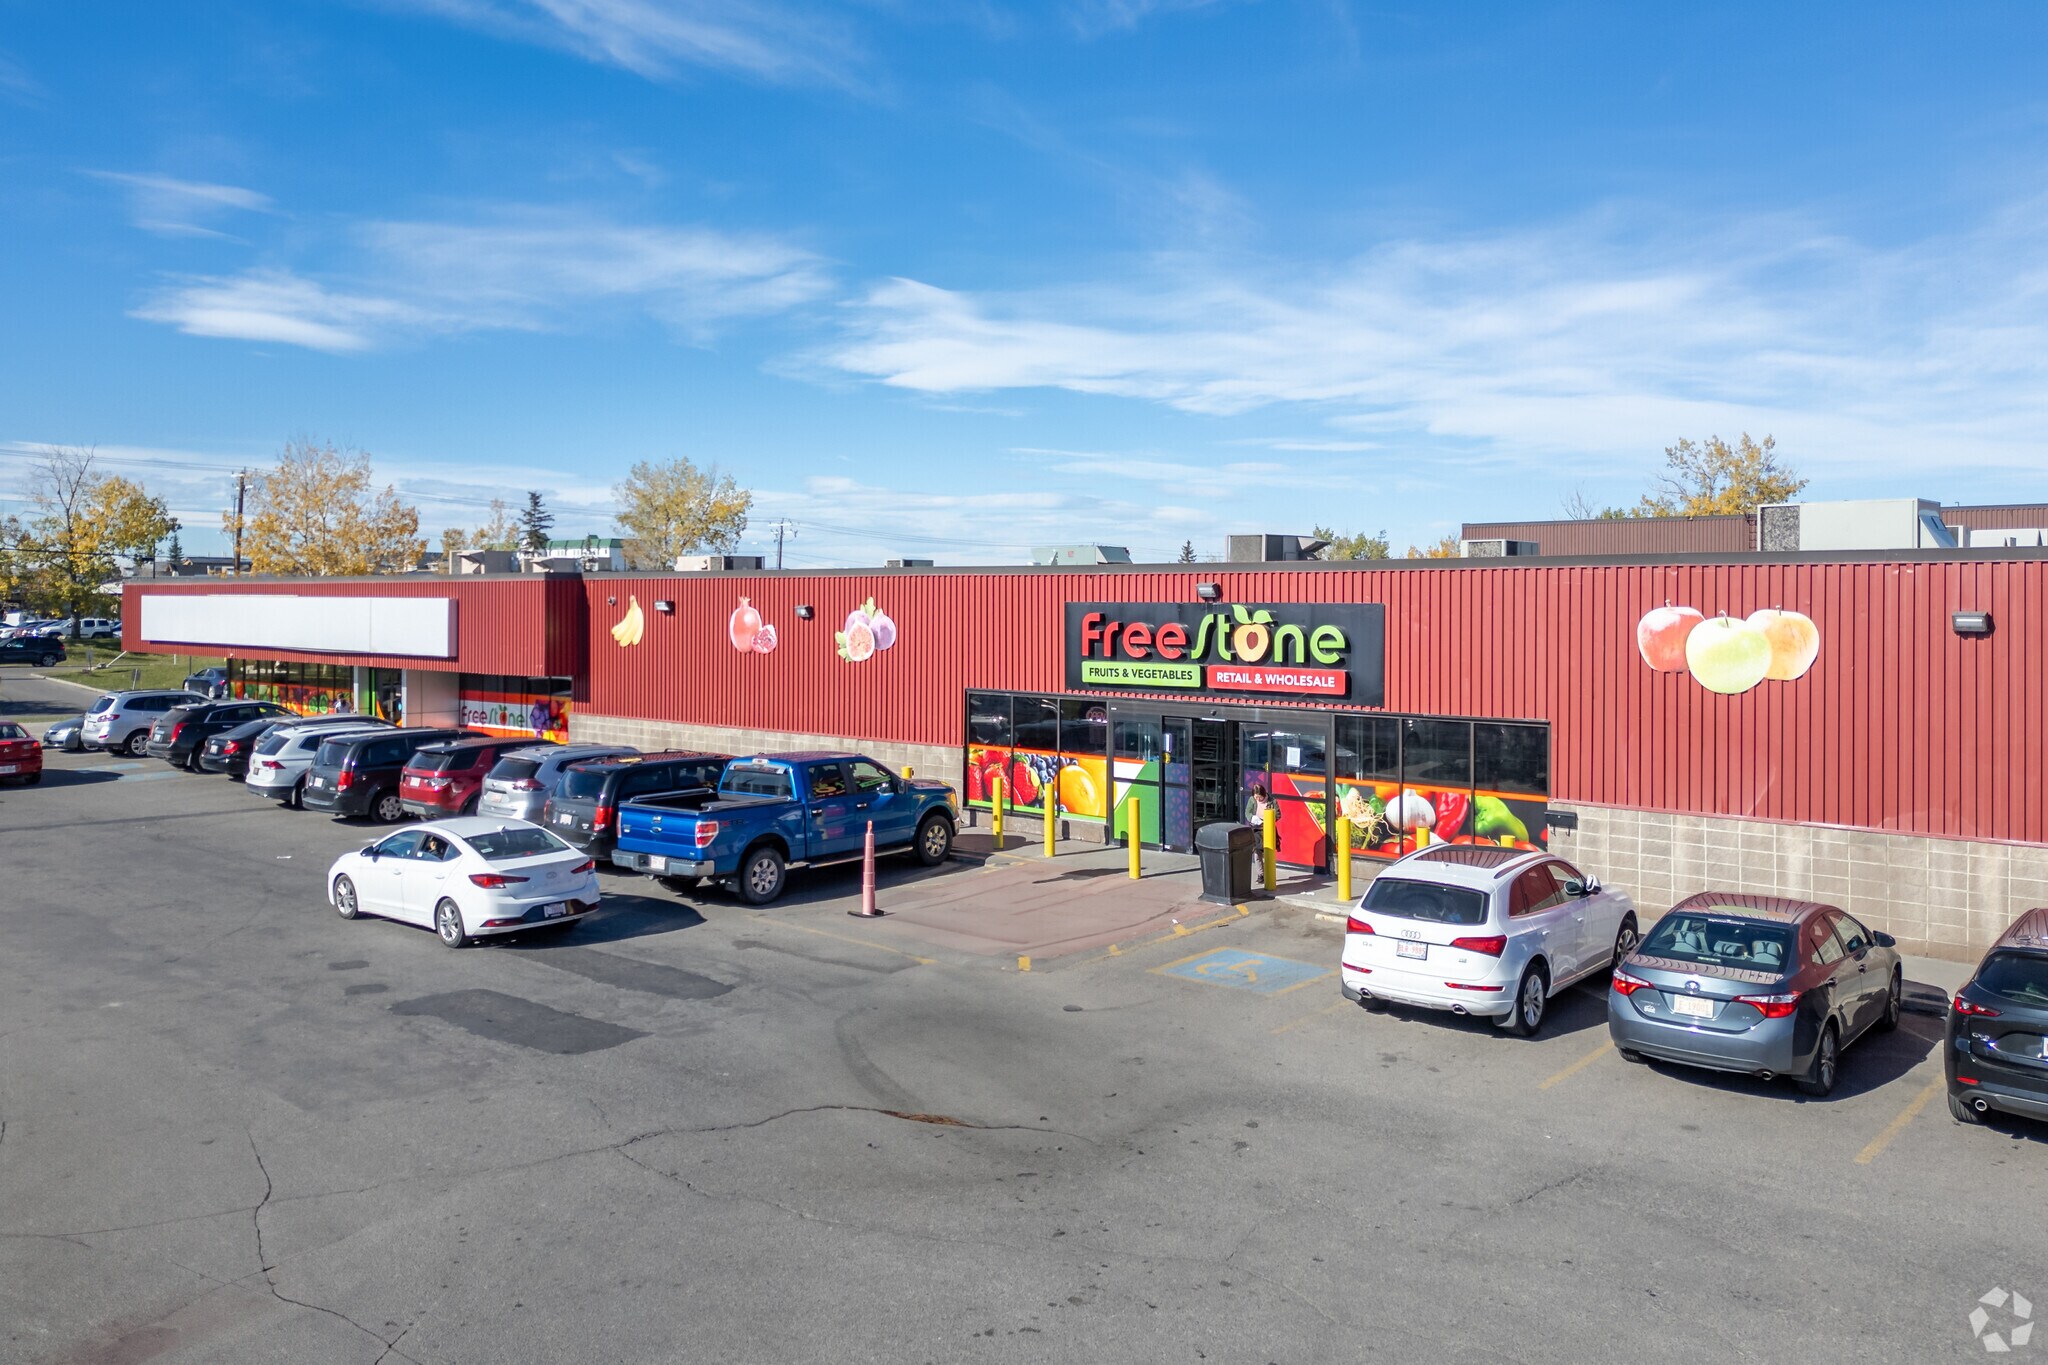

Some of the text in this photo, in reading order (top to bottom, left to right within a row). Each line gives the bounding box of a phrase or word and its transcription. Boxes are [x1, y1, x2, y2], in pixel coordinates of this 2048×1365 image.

[1088, 667, 1193, 681] FRUITS & VEGETABLES
[1216, 671, 1336, 688] RETAIL & WHOLESALE
